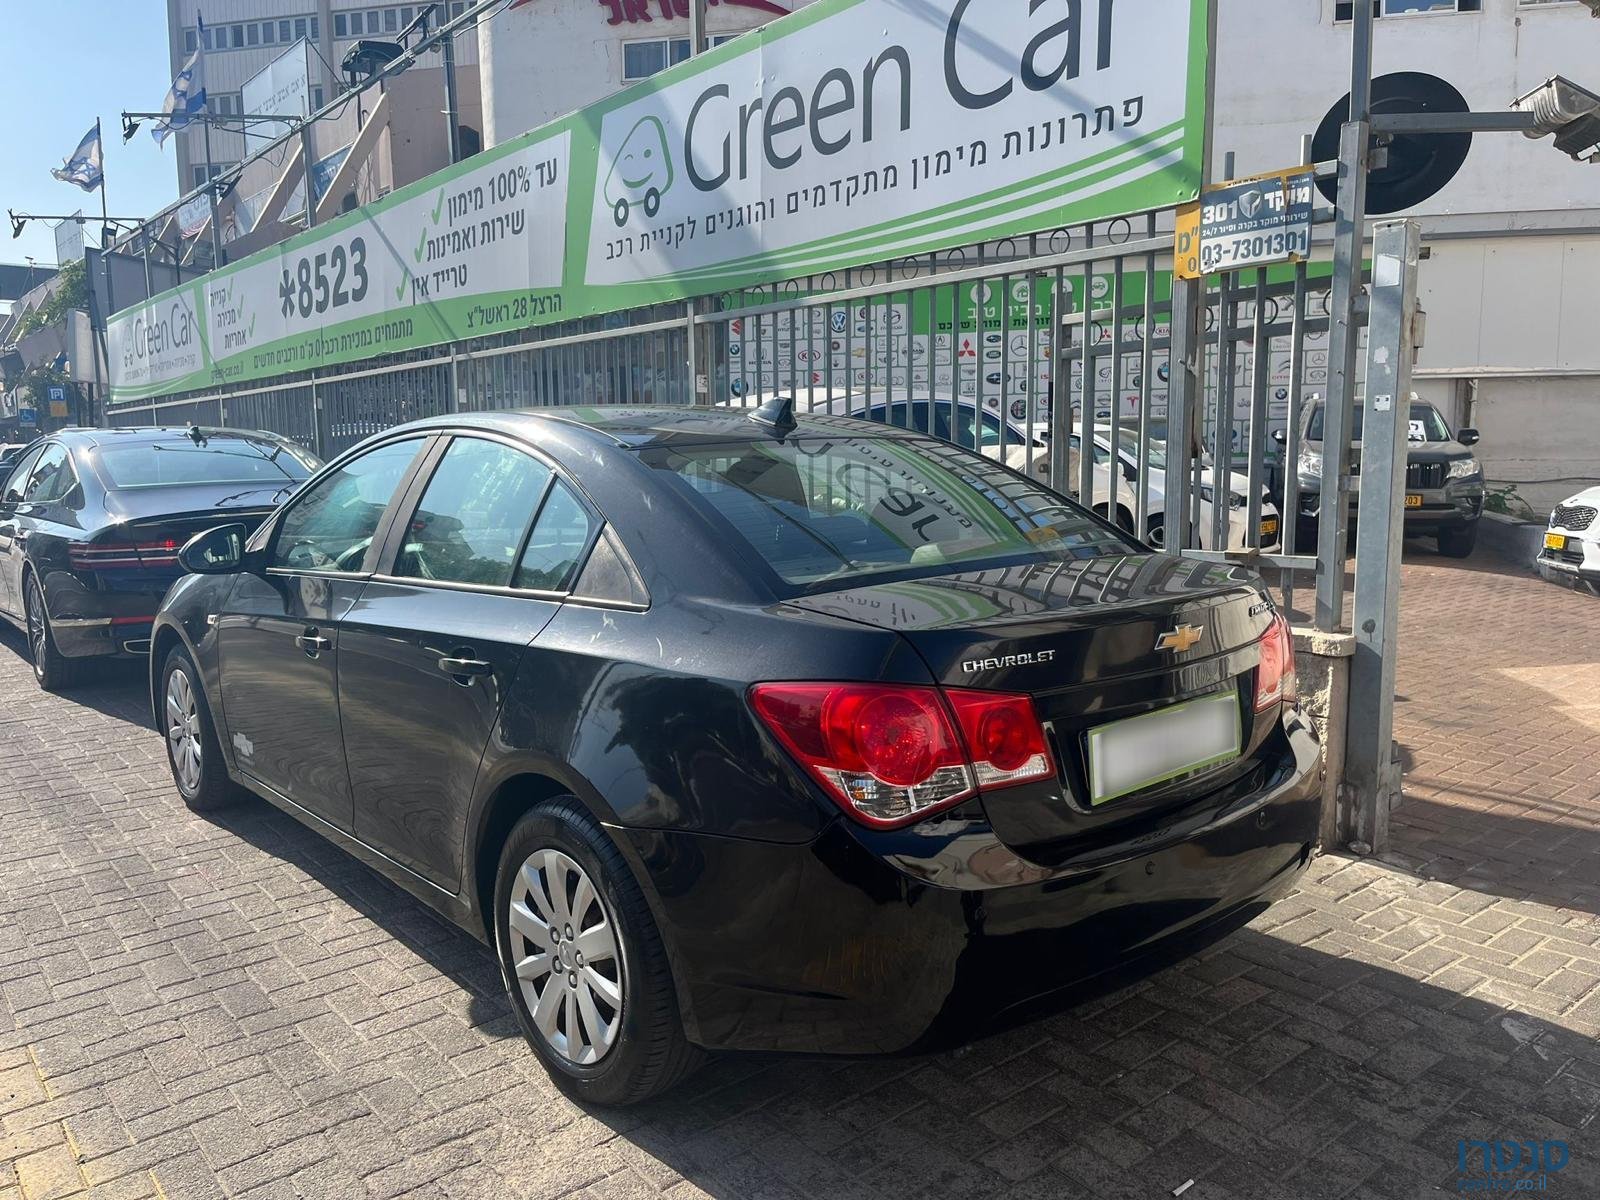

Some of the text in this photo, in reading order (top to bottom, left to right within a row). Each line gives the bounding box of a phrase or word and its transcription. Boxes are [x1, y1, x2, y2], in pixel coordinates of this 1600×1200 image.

[684, 44, 911, 192] Green
[448, 158, 557, 227] עד 100% מימון
[606, 95, 1144, 261] פתרונות מימון מתקדמים והוגנים לקניית רכב
[1202, 200, 1238, 225] 301
[427, 209, 525, 262] שירות ואמינות
[1201, 229, 1307, 264] 03-7301301
[412, 264, 468, 306] טרייד אין
[513, 297, 527, 320] 28
[530, 293, 562, 316] הרצל
[133, 303, 194, 360] Green Car
[341, 328, 373, 352] במכירת
[375, 318, 413, 343] מתמחים
[963, 649, 1056, 673] CHEVROLET
